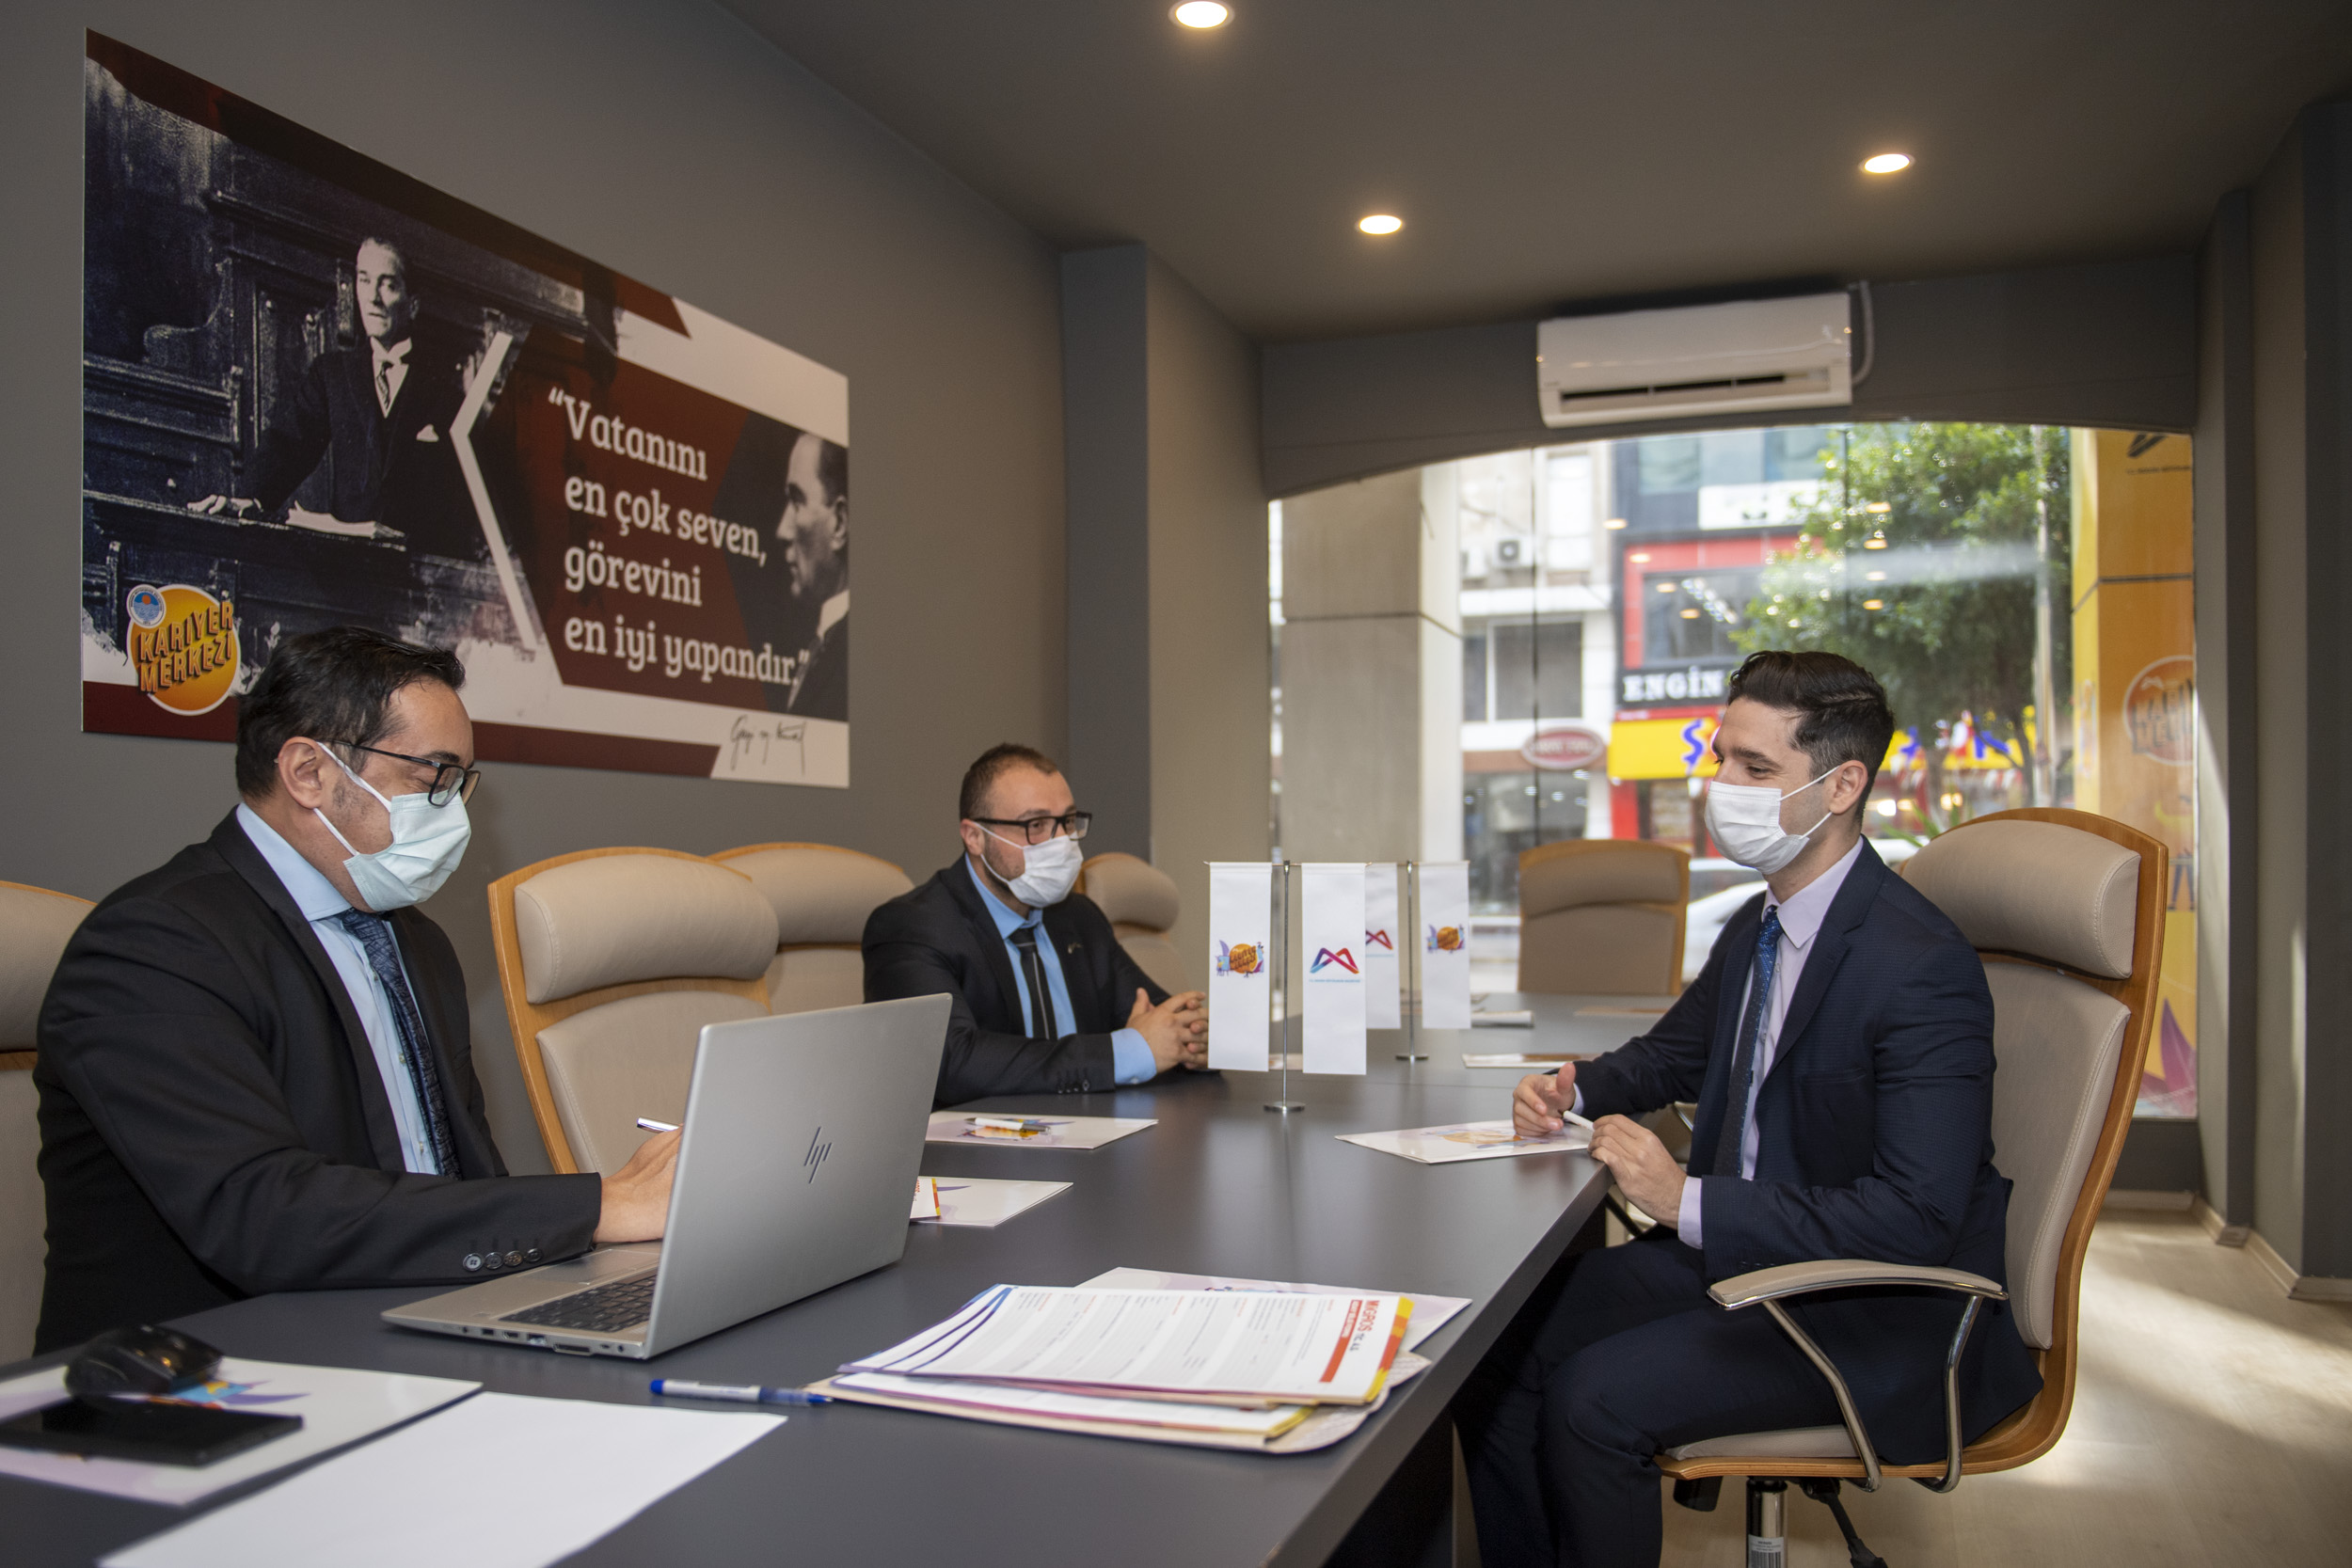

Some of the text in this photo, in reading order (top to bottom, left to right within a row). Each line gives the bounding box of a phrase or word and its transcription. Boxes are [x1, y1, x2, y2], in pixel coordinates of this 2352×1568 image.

[548, 386, 707, 481] “Vatanını
[564, 475, 768, 568] en çok seven,
[564, 540, 703, 607] görevini
[564, 615, 608, 656] en
[614, 614, 658, 673] iyi
